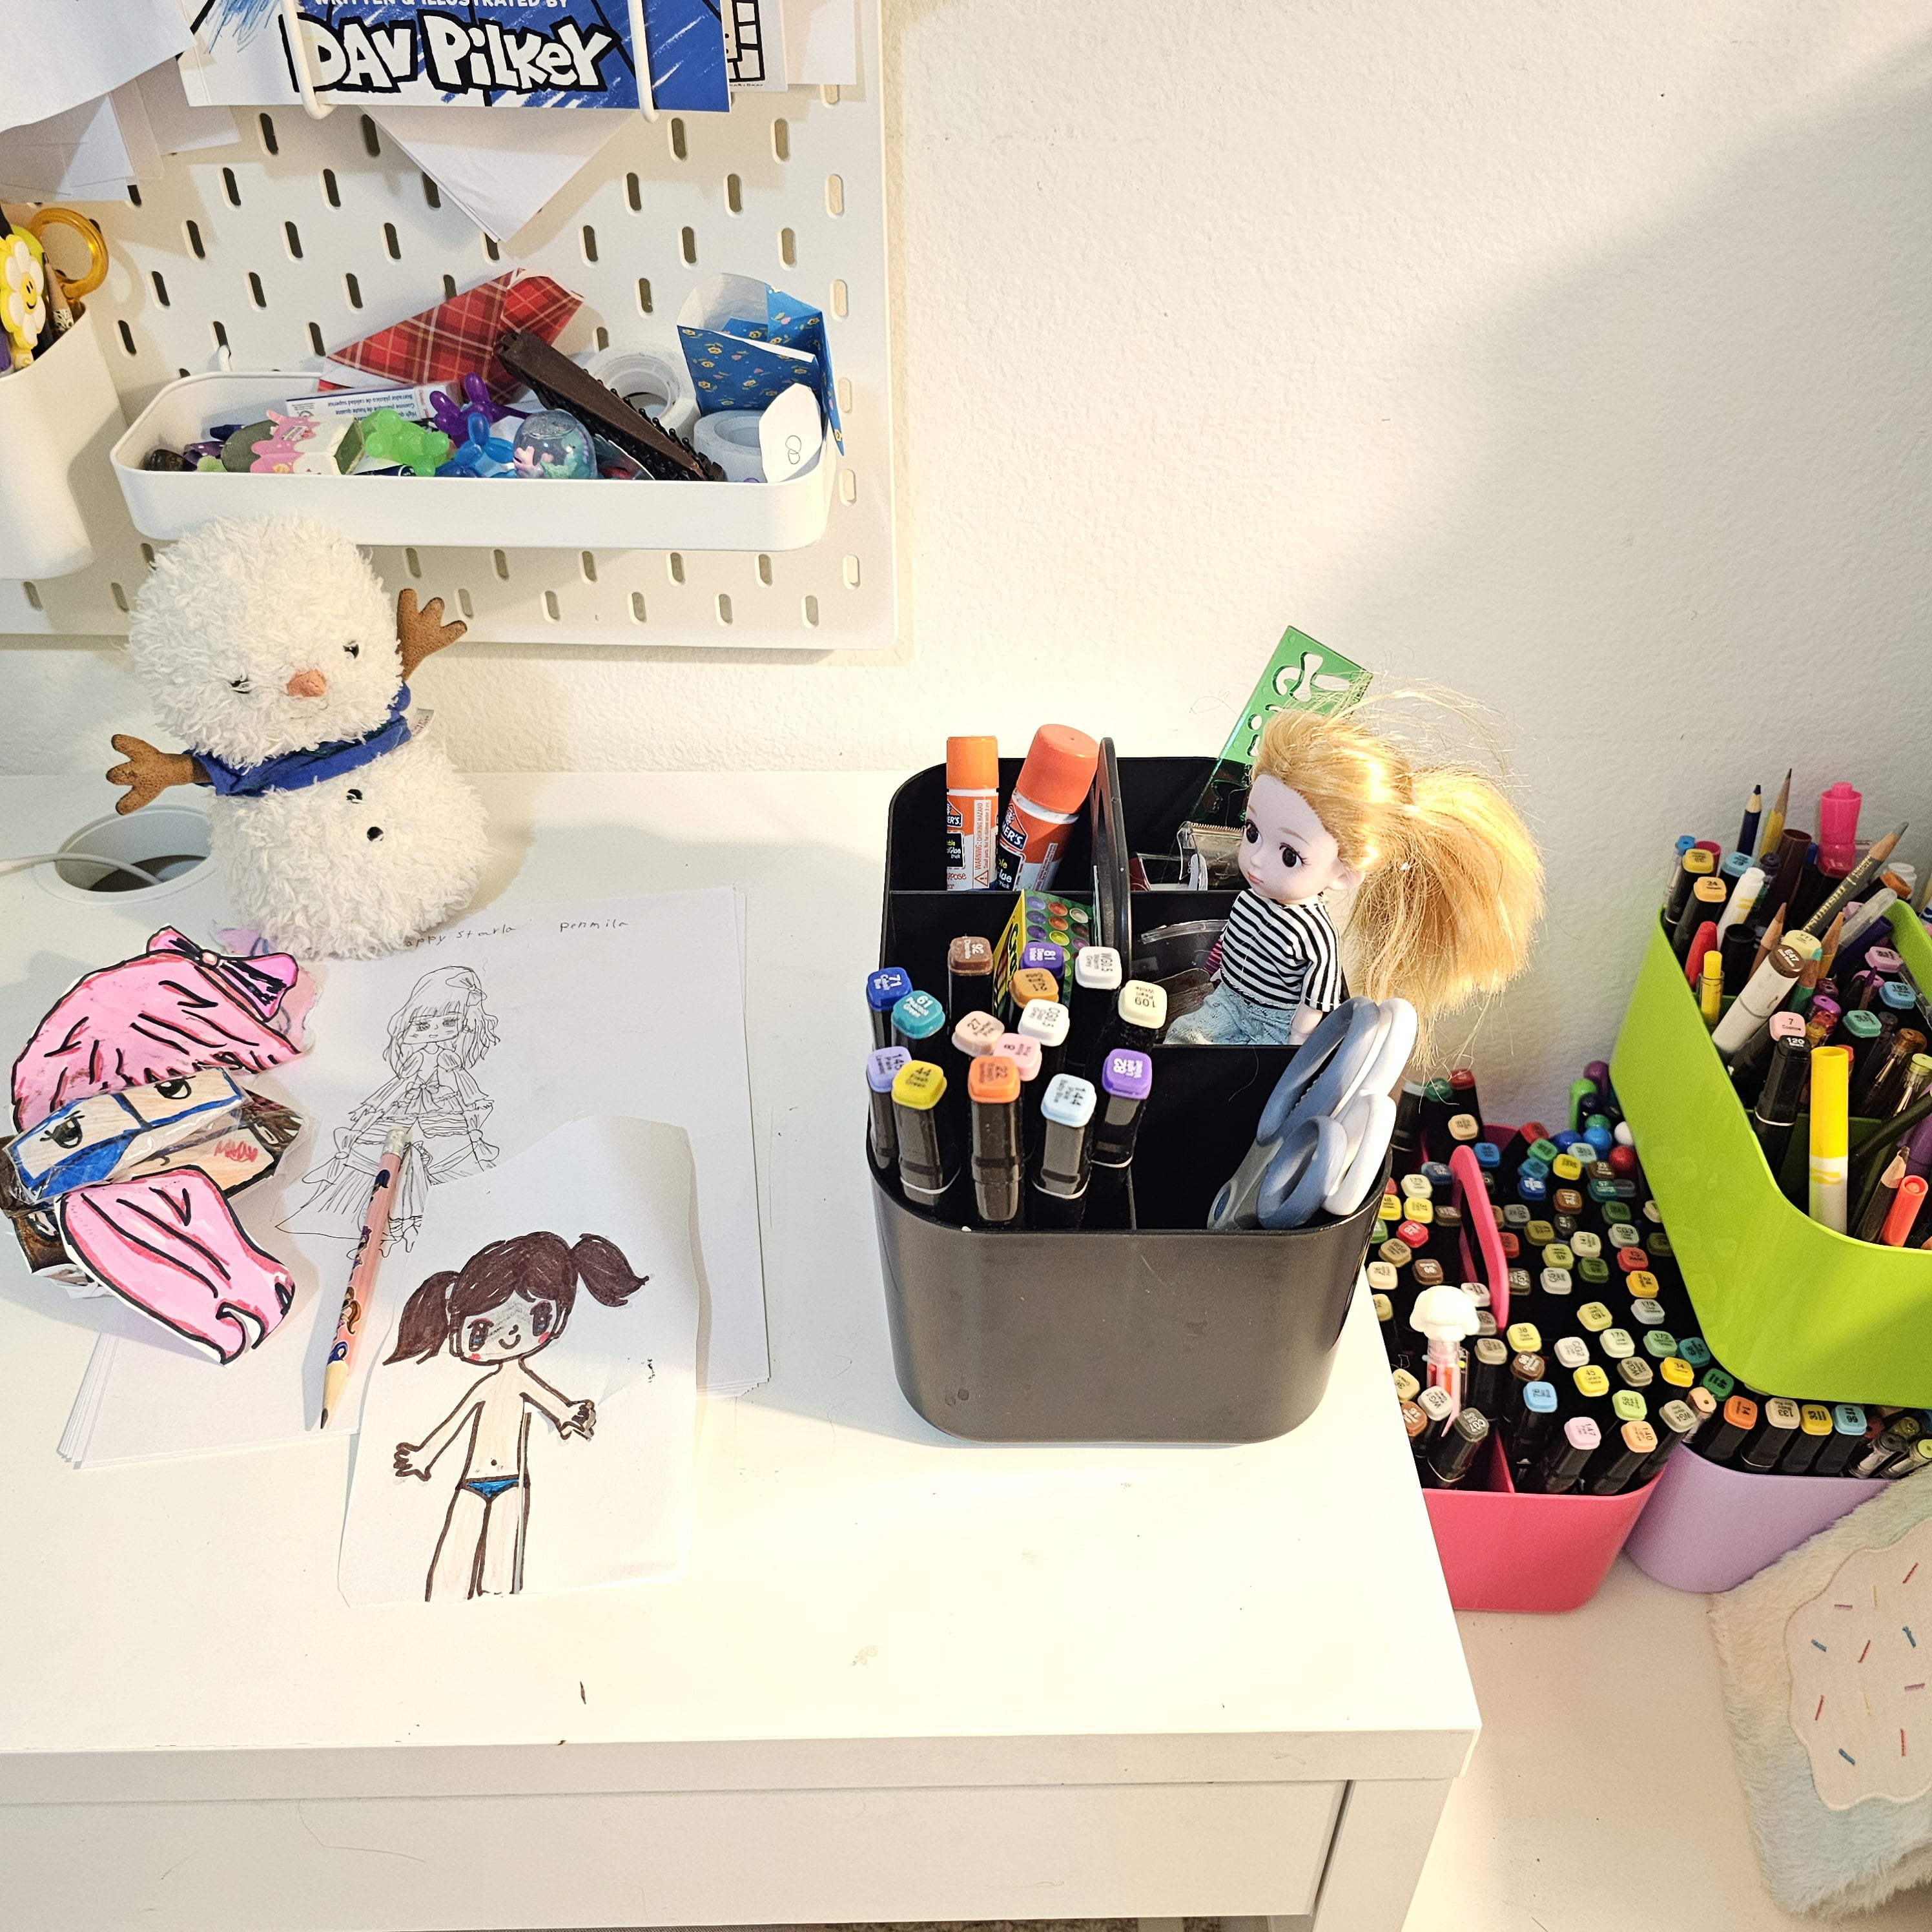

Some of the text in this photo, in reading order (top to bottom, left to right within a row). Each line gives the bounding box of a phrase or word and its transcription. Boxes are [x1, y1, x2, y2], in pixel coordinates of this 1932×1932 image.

[947, 816, 961, 825] ER'S
[971, 943, 985, 955] 92
[1043, 950, 1056, 960] 81
[1784, 949, 1800, 962] E47
[1100, 952, 1113, 972] WG0.5
[889, 974, 902, 987] 71
[1033, 981, 1047, 992] 21
[1135, 996, 1156, 1008] 109
[1136, 992, 1153, 1000] Pearl
[916, 996, 934, 1009] 61
[967, 1018, 981, 1031] 27
[1786, 1036, 1805, 1045] 120
[892, 1054, 905, 1071] 145
[1113, 1058, 1127, 1074] 82
[916, 1067, 932, 1077] 44
[996, 1065, 1008, 1078] 22
[1070, 1087, 1086, 1106] 144
[1517, 1270, 1528, 1286] WG9
[1572, 1341, 1585, 1357] CG2
[1533, 1389, 1541, 1397] 76
[1425, 1392, 1442, 1410] WG1
[1621, 1396, 1630, 1406] 59
[1412, 1408, 1421, 1418] 91
[1741, 1406, 1751, 1416] 14
[1778, 1409, 1794, 1417] 133
[1808, 1411, 1818, 1421] 33
[1585, 1423, 1597, 1436] 147
[1643, 1427, 1653, 1441] 140
